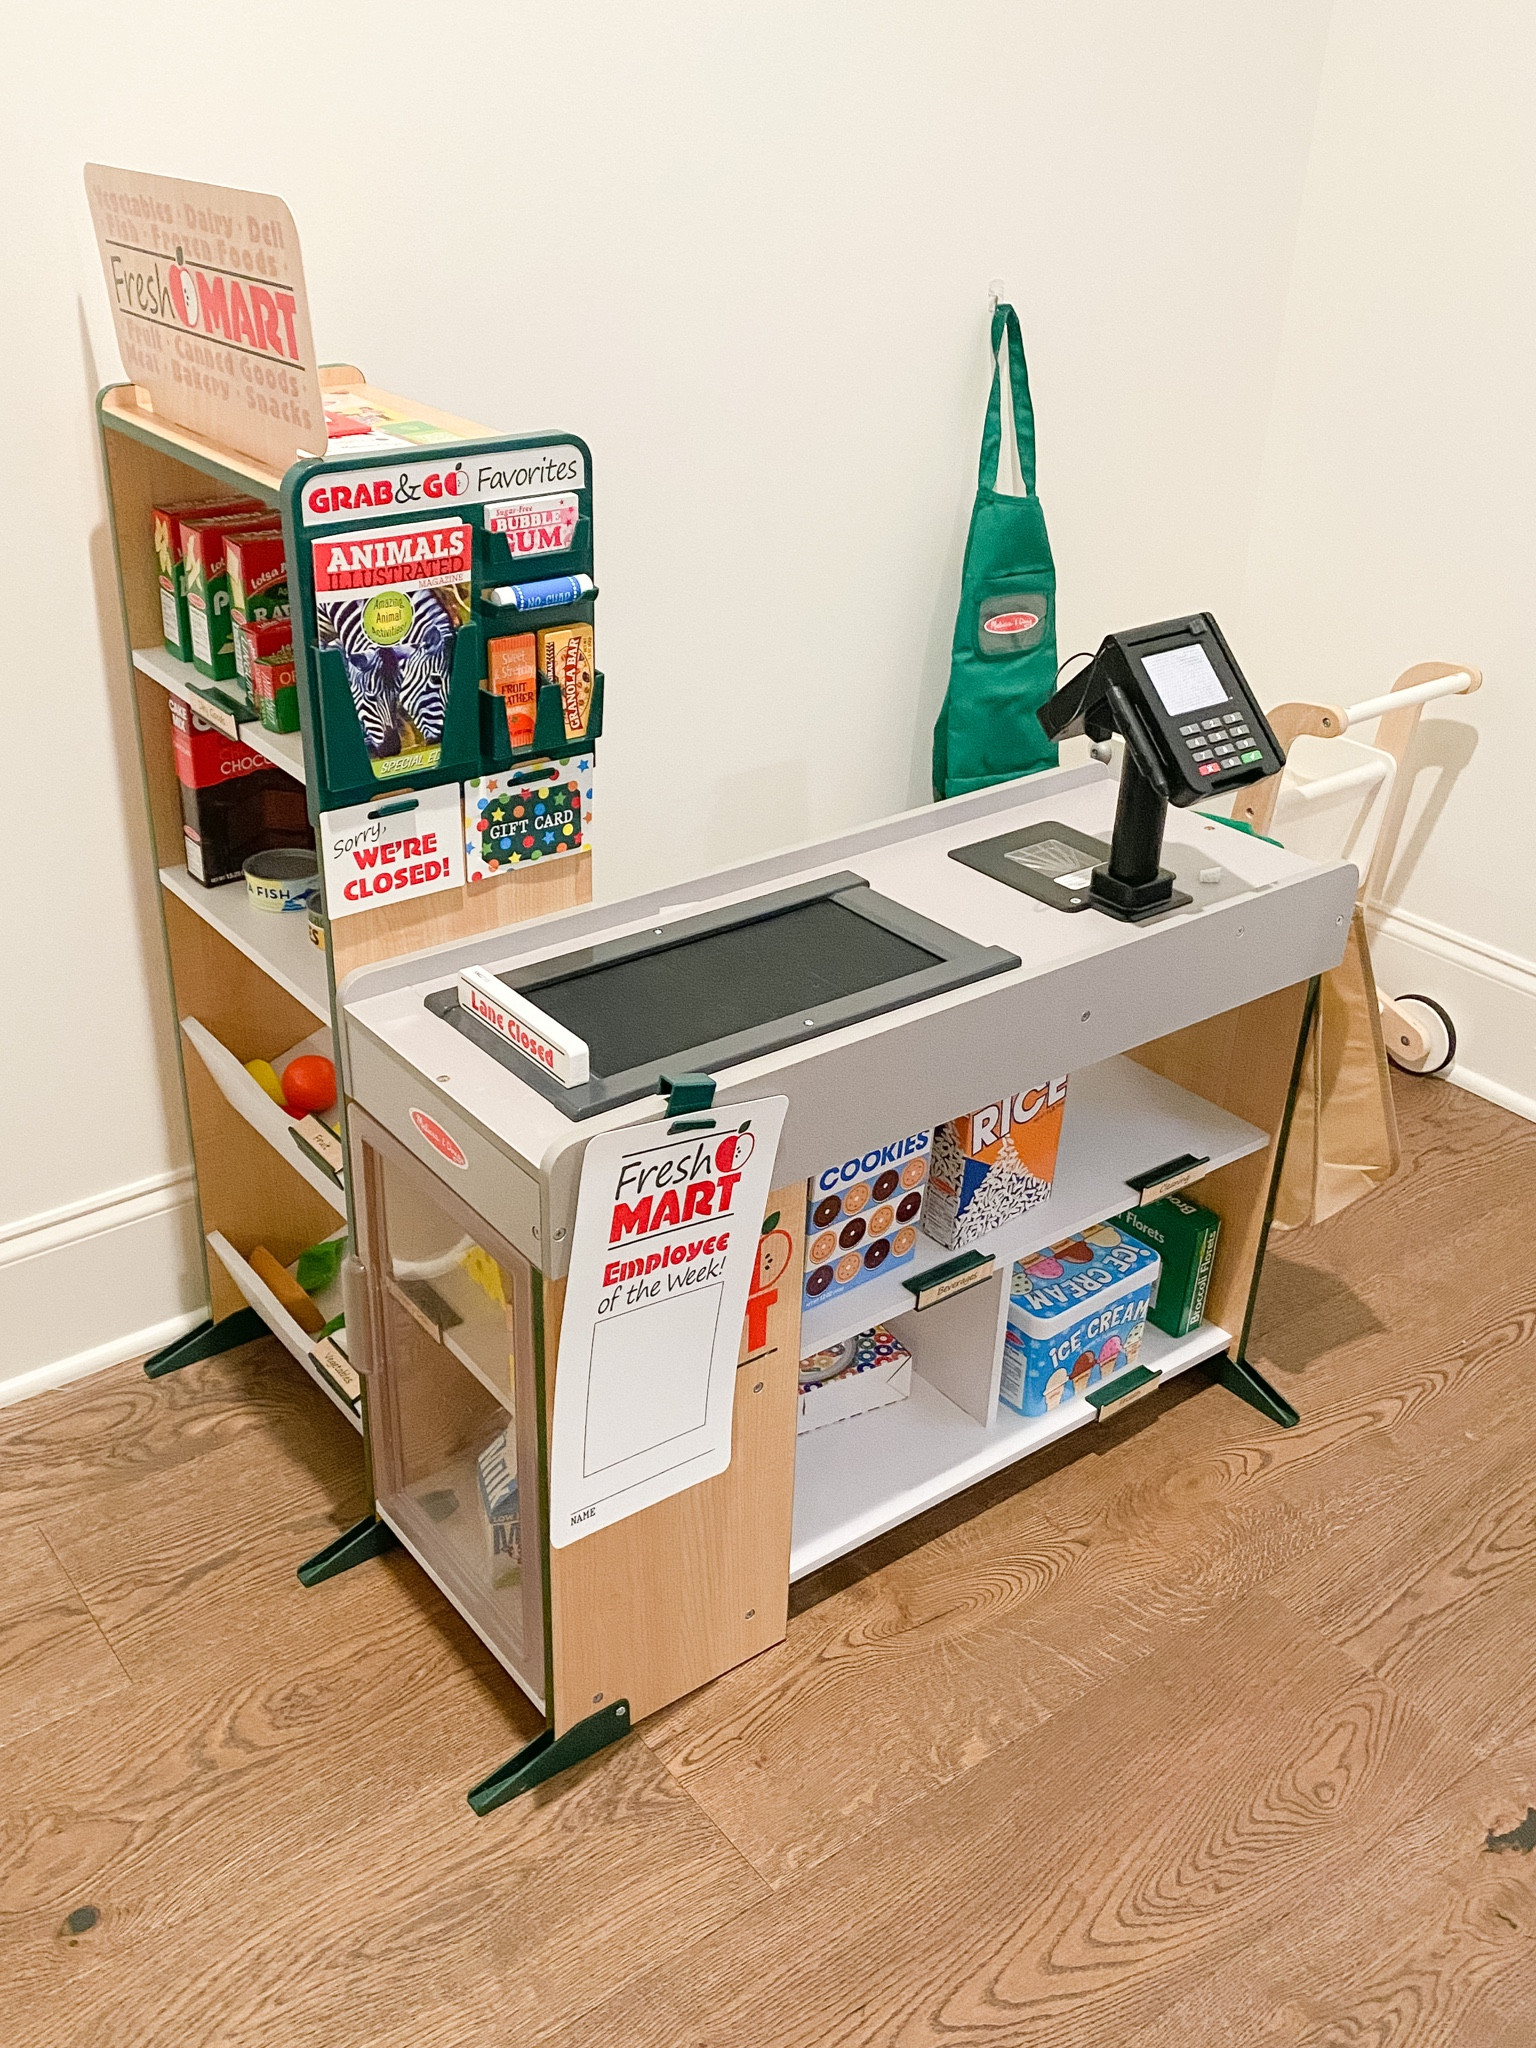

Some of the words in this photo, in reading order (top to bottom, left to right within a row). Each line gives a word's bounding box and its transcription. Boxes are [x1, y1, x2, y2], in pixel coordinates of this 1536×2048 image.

[94, 187, 174, 225] Vegetables
[186, 203, 233, 240] Dairy
[107, 212, 139, 243] Fish
[152, 224, 212, 263] Frozen
[217, 246, 278, 277] Foods
[110, 255, 175, 319] Fresh
[196, 271, 299, 361] MART
[127, 320, 163, 352] Fruit
[174, 335, 235, 377] Canned
[242, 358, 299, 398] Goods
[127, 345, 160, 375] Meat
[172, 363, 230, 402] Bakery
[247, 388, 312, 430] Snacks
[478, 456, 577, 492] Favorites
[496, 505, 533, 516] Sugar-Free
[496, 510, 562, 532] BUBBLE
[327, 531, 465, 573] ANIMALS
[328, 555, 465, 592] ILLUSTRATED
[418, 573, 464, 589] MAGAZINE
[374, 598, 405, 611] Amazing
[376, 610, 402, 624] Animal
[502, 651, 526, 664] Sweet
[569, 637, 580, 665] BAR
[501, 682, 527, 695] FRUIT
[505, 691, 535, 707] ATHER
[567, 667, 580, 729] GRANOLA
[381, 754, 424, 774] SPECIAL
[334, 822, 387, 859] Sorry,
[489, 819, 529, 840] GIFT
[535, 809, 574, 830] CARD
[352, 833, 437, 870] WE'RE
[257, 887, 290, 900] FISH
[344, 857, 450, 901] CLOSED!
[471, 990, 504, 1031] Lane
[507, 1019, 555, 1069] Closed
[971, 1073, 1068, 1157] RICE
[615, 1143, 712, 1201] Fresh
[819, 1129, 930, 1192] COOKIES
[608, 1171, 742, 1244] MART
[1125, 1211, 1166, 1244] Florets
[602, 1232, 730, 1288] Employee
[1189, 1275, 1207, 1325] Broccoli
[1200, 1230, 1216, 1274] Florets
[597, 1284, 622, 1315] of
[627, 1277, 662, 1305] the
[667, 1256, 728, 1293] Week!
[937, 1271, 979, 1298] Beverages
[1023, 1265, 1114, 1311] CREAM
[1087, 1298, 1151, 1340] CREAM
[323, 1349, 353, 1386] Vegetables
[570, 1507, 596, 1526] NAME
